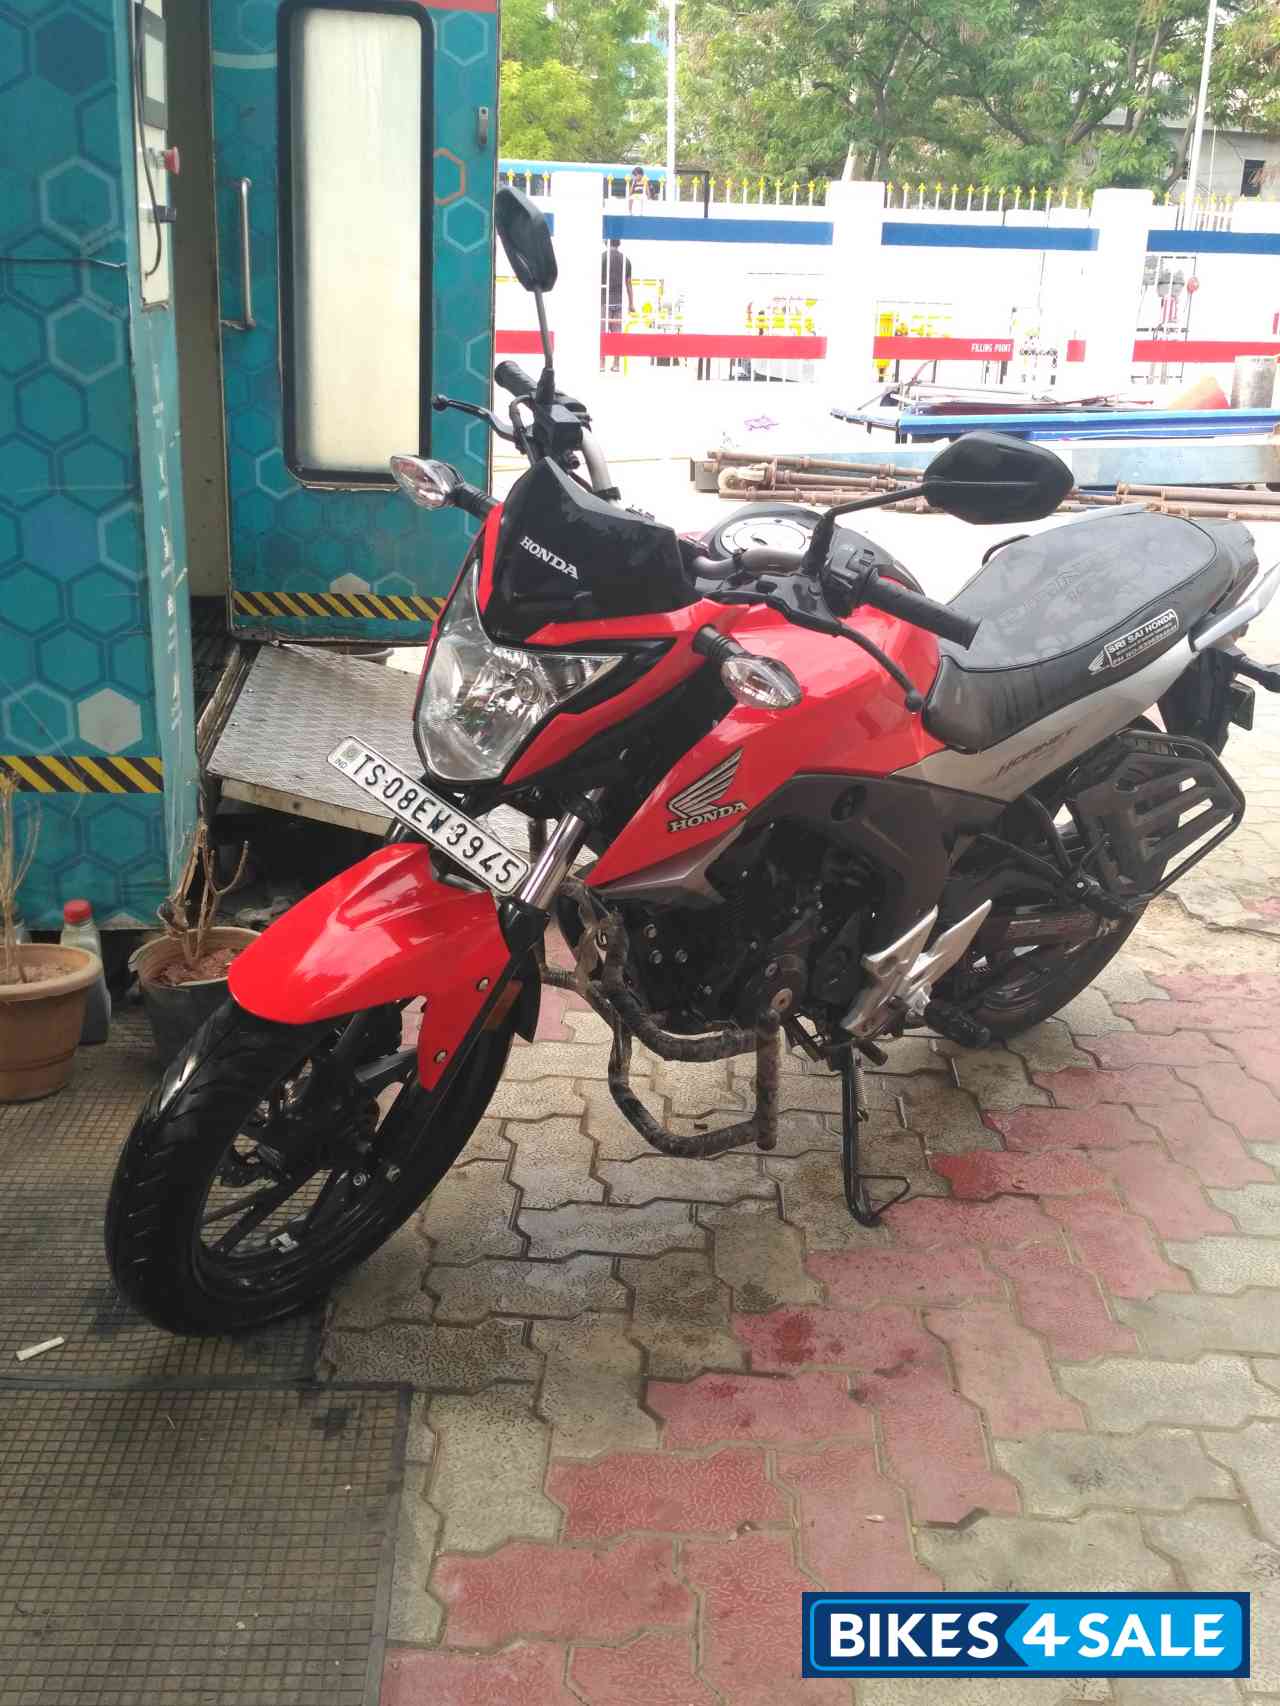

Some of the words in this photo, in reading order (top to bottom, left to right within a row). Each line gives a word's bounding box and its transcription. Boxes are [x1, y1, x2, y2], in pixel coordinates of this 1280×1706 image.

[971, 343, 992, 353] FILLING
[994, 343, 1011, 353] POINT
[520, 536, 579, 580] HONDA
[1107, 639, 1127, 654] SRI
[1127, 629, 1145, 643] SAI
[1145, 612, 1176, 633] HONDA
[668, 802, 749, 832] HONDA
